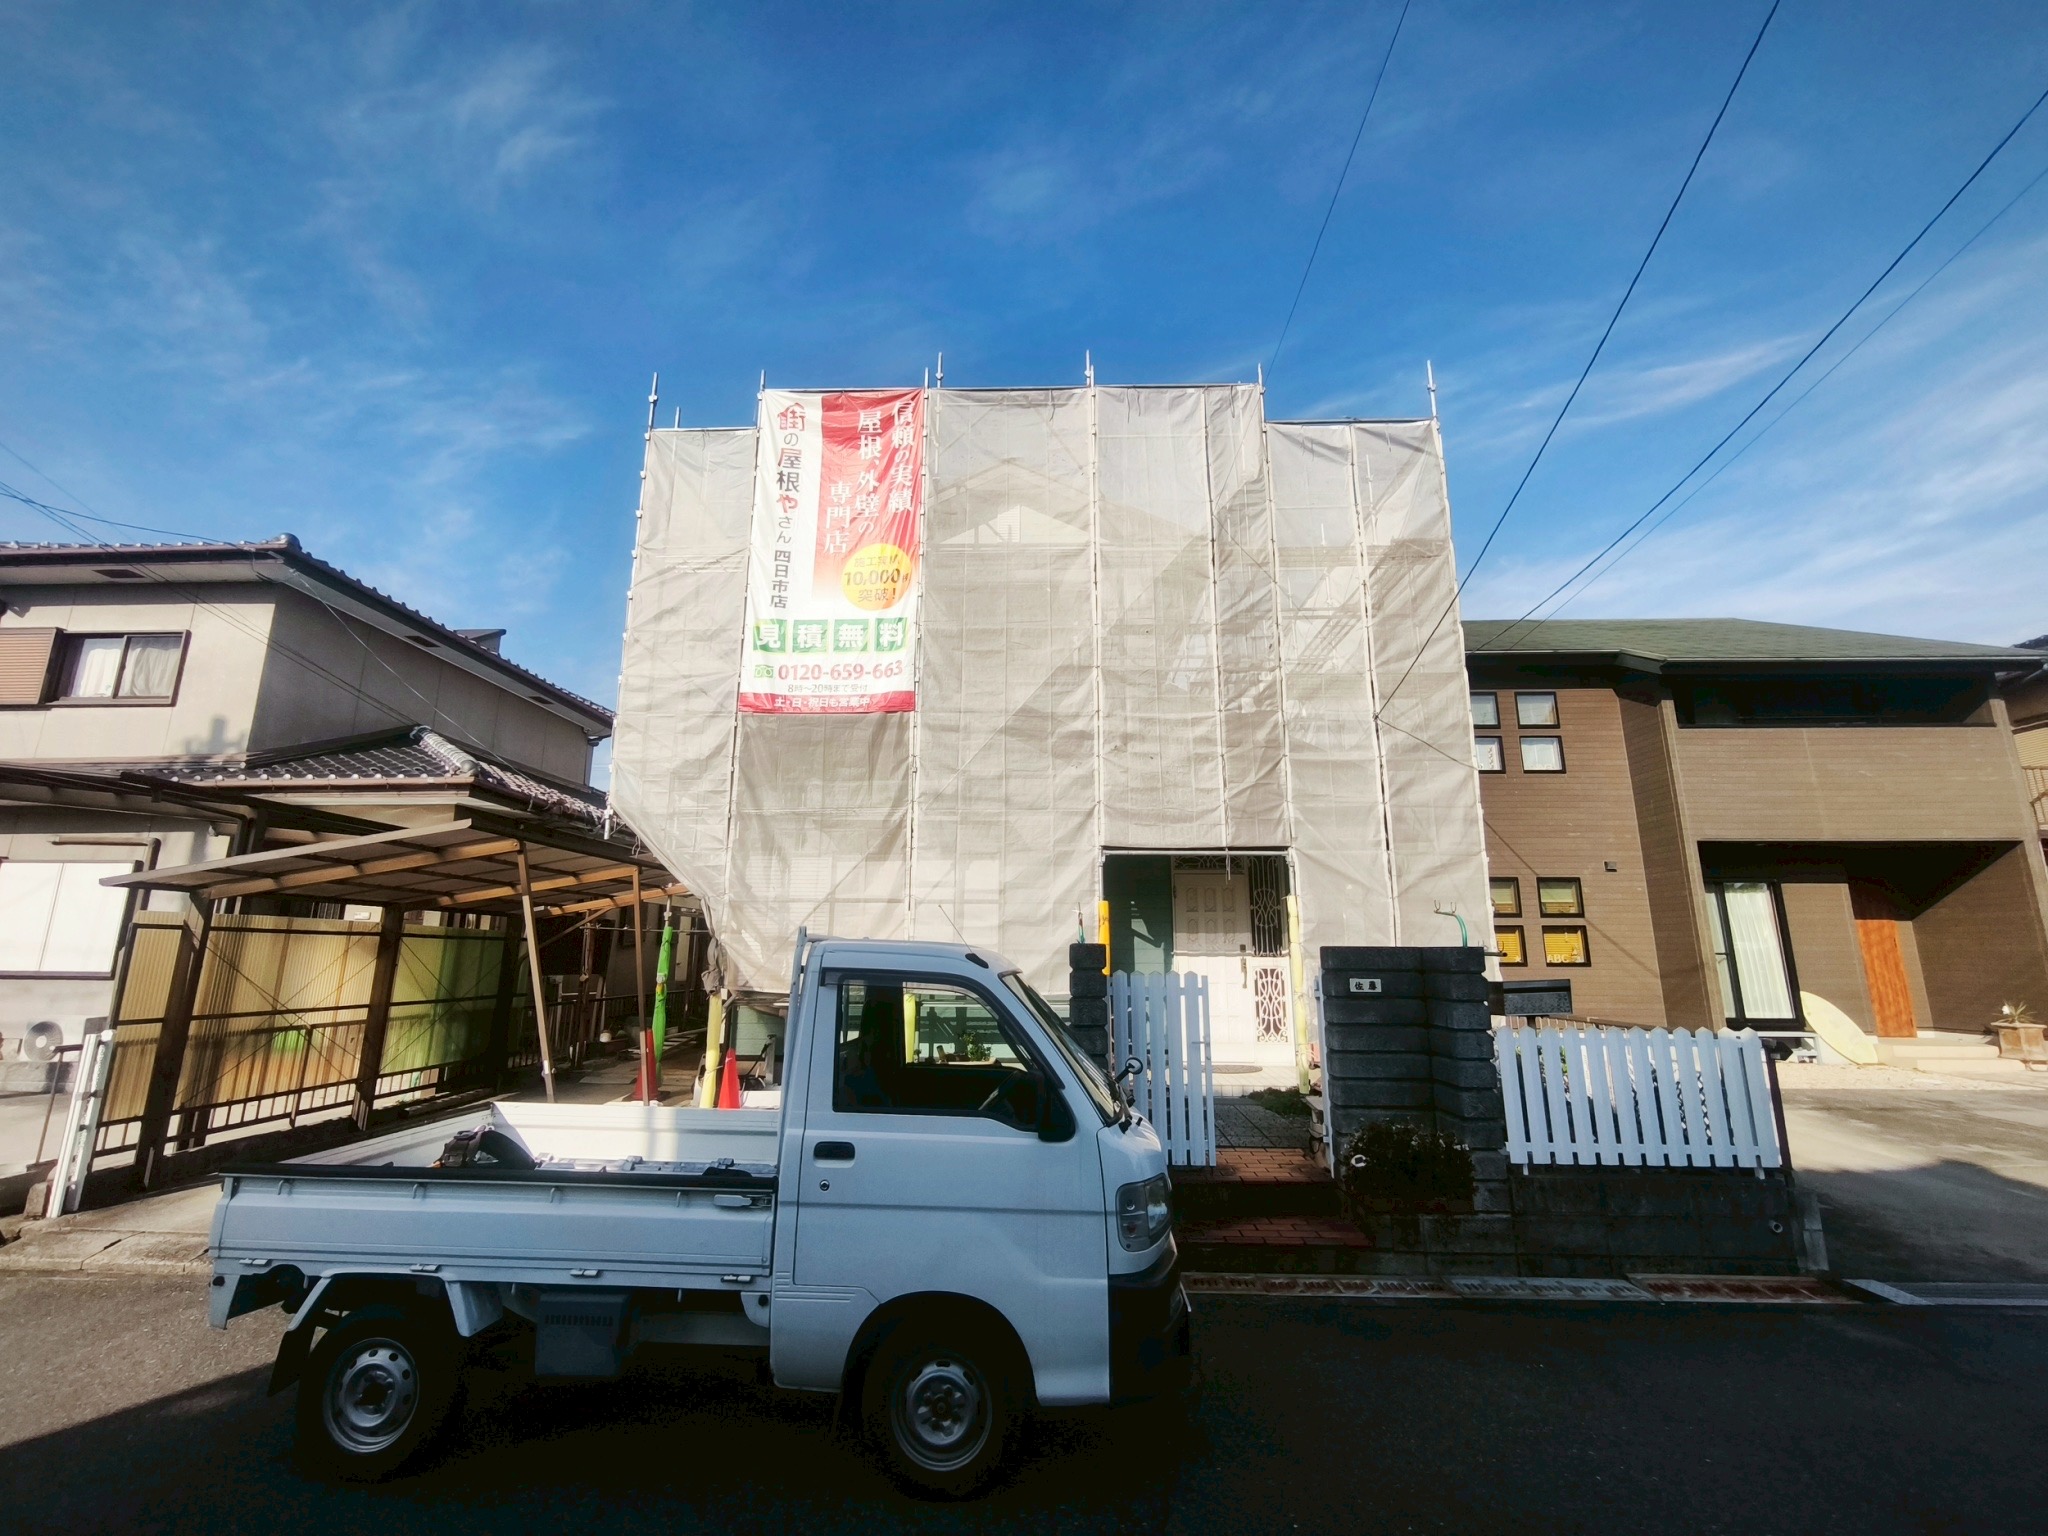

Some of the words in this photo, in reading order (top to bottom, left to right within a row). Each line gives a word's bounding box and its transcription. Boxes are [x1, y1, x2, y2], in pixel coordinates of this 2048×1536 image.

[854, 410, 883, 534] 屋根、外壁の
[887, 399, 915, 514] 信頼の実績
[823, 482, 852, 554] 専門店
[758, 622, 904, 649] 見積無料
[778, 659, 903, 681] 0120-659-663
[1547, 954, 1568, 963] ABC
